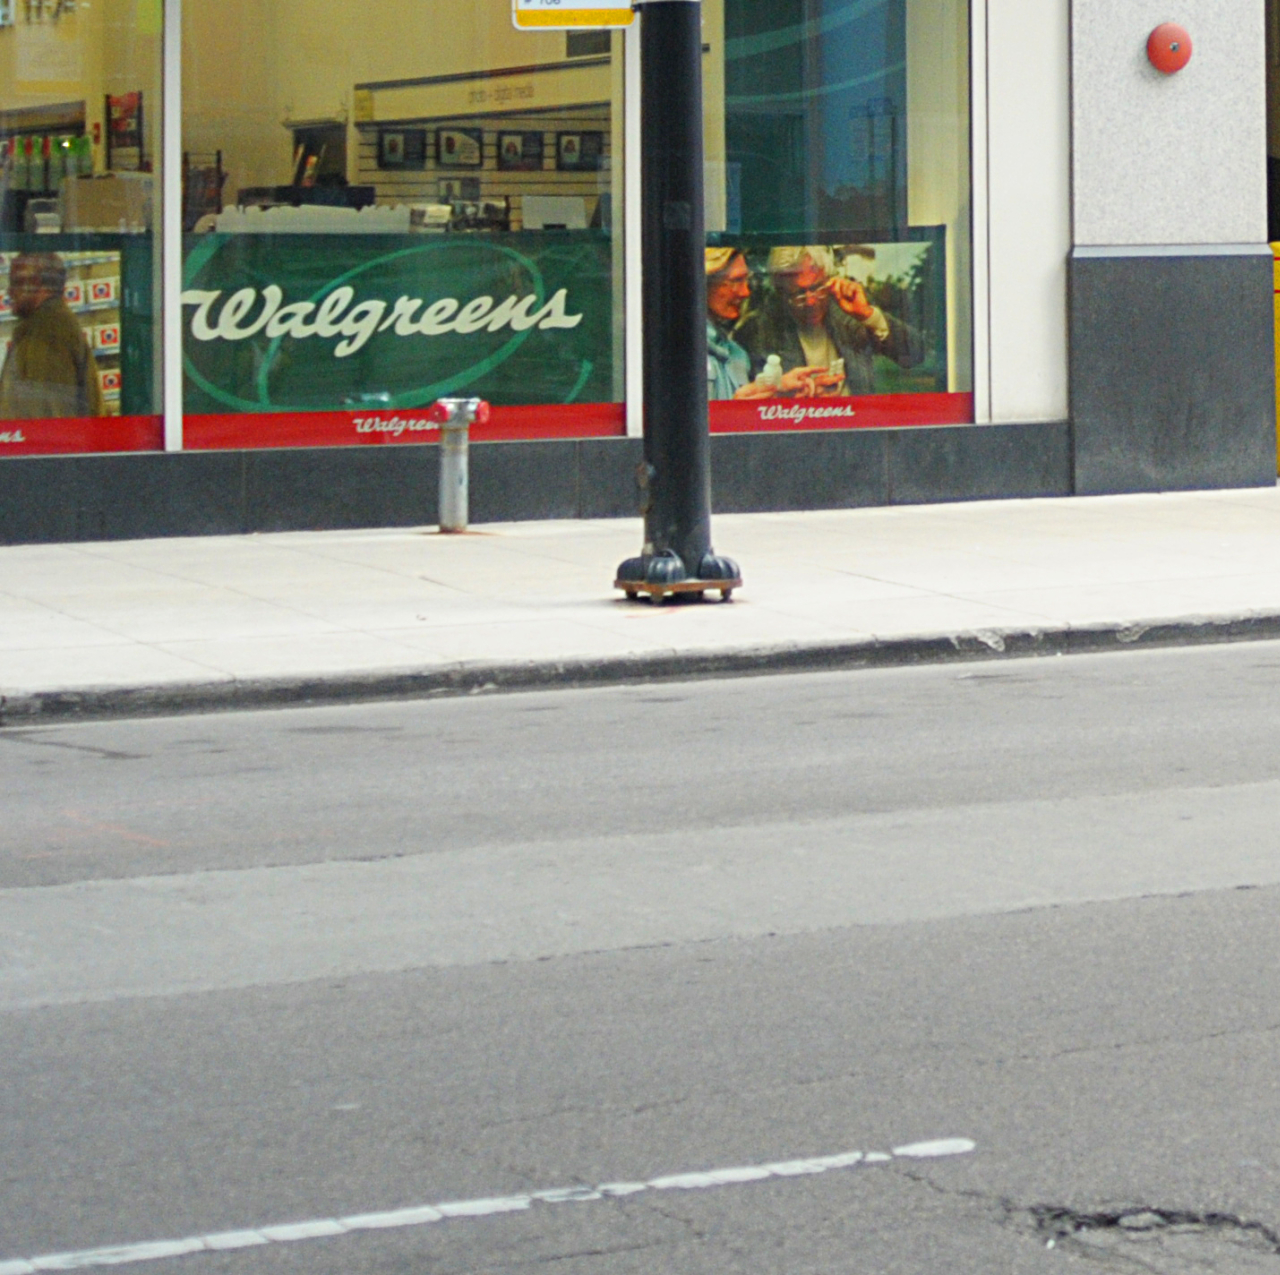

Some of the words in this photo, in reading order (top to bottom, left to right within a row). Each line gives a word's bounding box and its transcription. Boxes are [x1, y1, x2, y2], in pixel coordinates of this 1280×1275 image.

[181, 284, 584, 358] Walgreens
[757, 403, 856, 424] Walgreens
[352, 416, 439, 438] Walgreen
